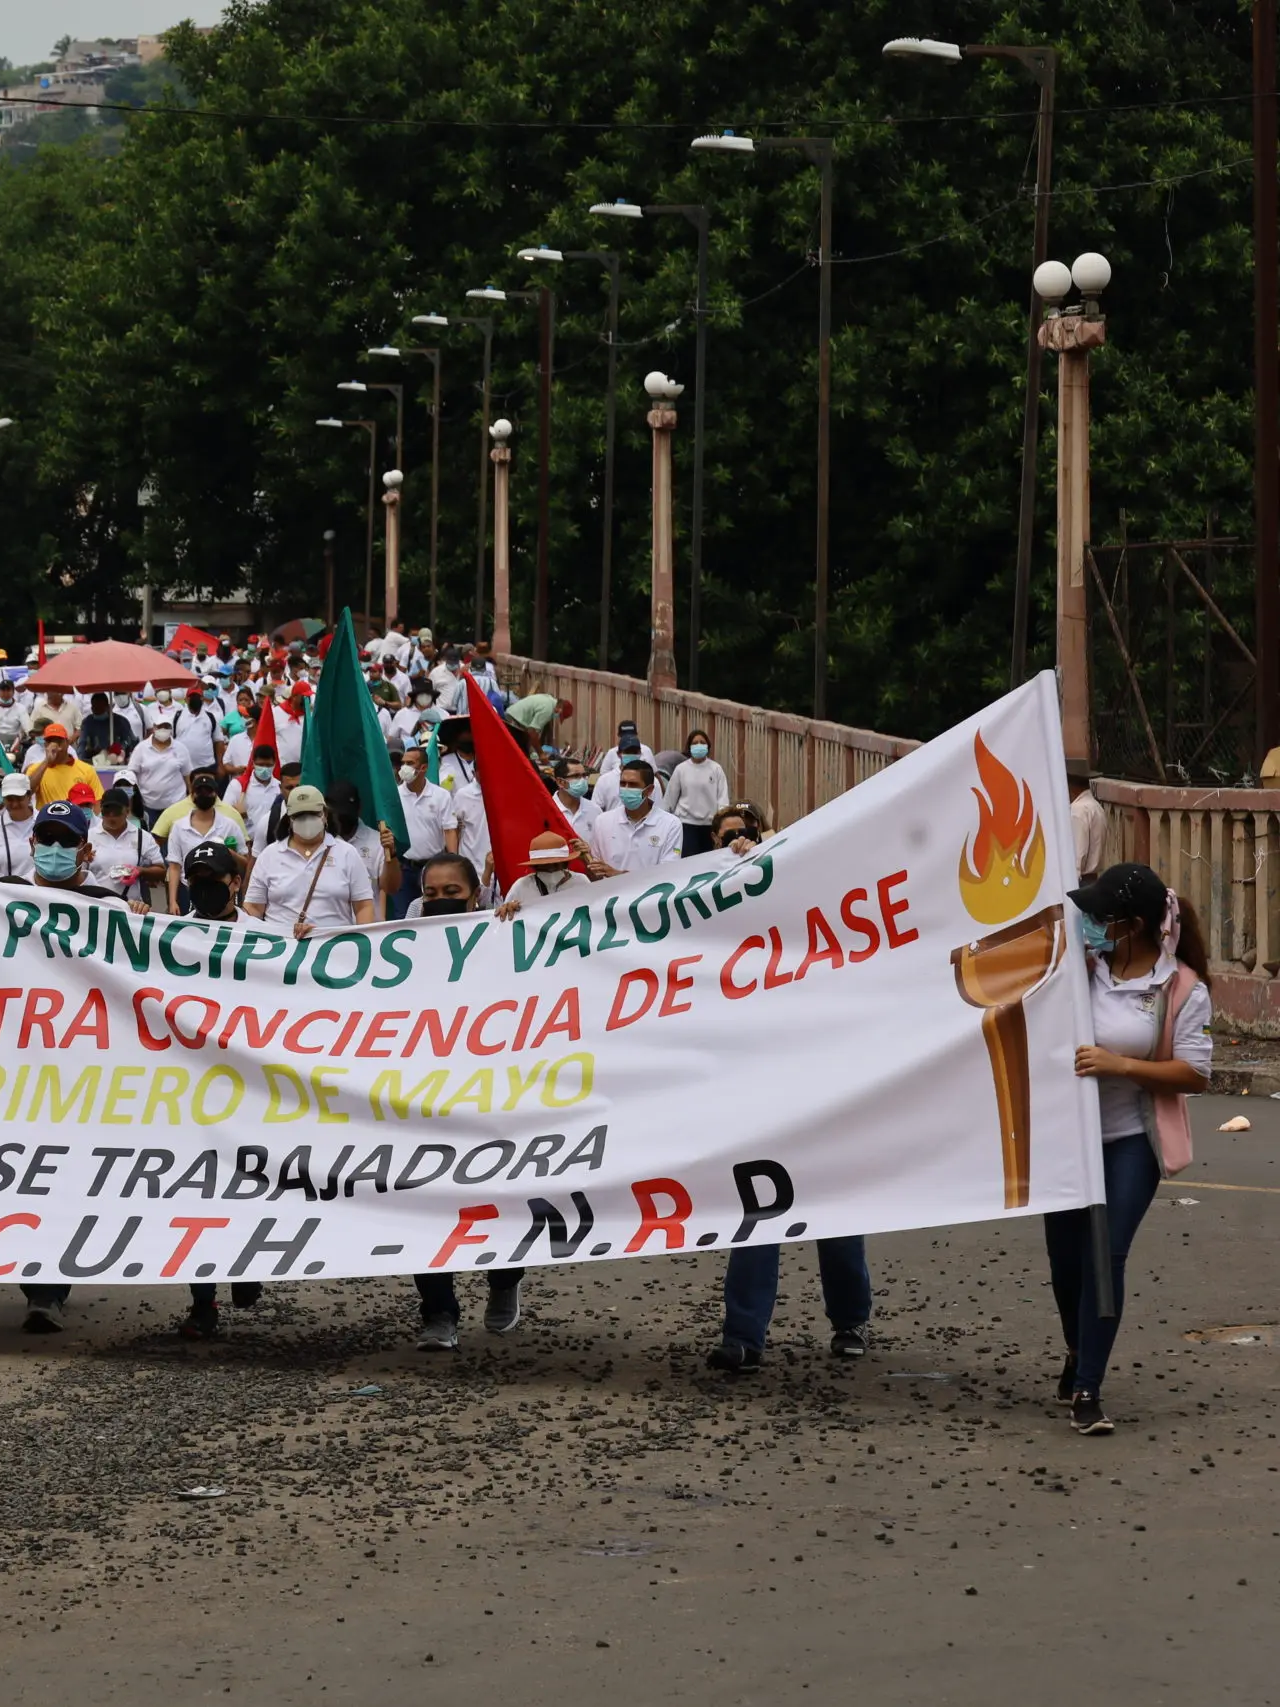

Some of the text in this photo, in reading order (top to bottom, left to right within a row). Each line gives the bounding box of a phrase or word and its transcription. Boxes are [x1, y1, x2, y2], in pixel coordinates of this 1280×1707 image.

[2, 900, 417, 990] PRINCIPIOS
[445, 922, 489, 983] Y
[513, 838, 777, 974] VALORES
[131, 986, 582, 1058] CONCIENCIA
[605, 954, 703, 1032] DE
[719, 868, 920, 1000] CLASE
[262, 1063, 350, 1124] DE
[370, 1052, 595, 1120] MAYO
[86, 1124, 607, 1203] TRABAJADORA
[429, 1159, 808, 1271] F.N.R.P.
